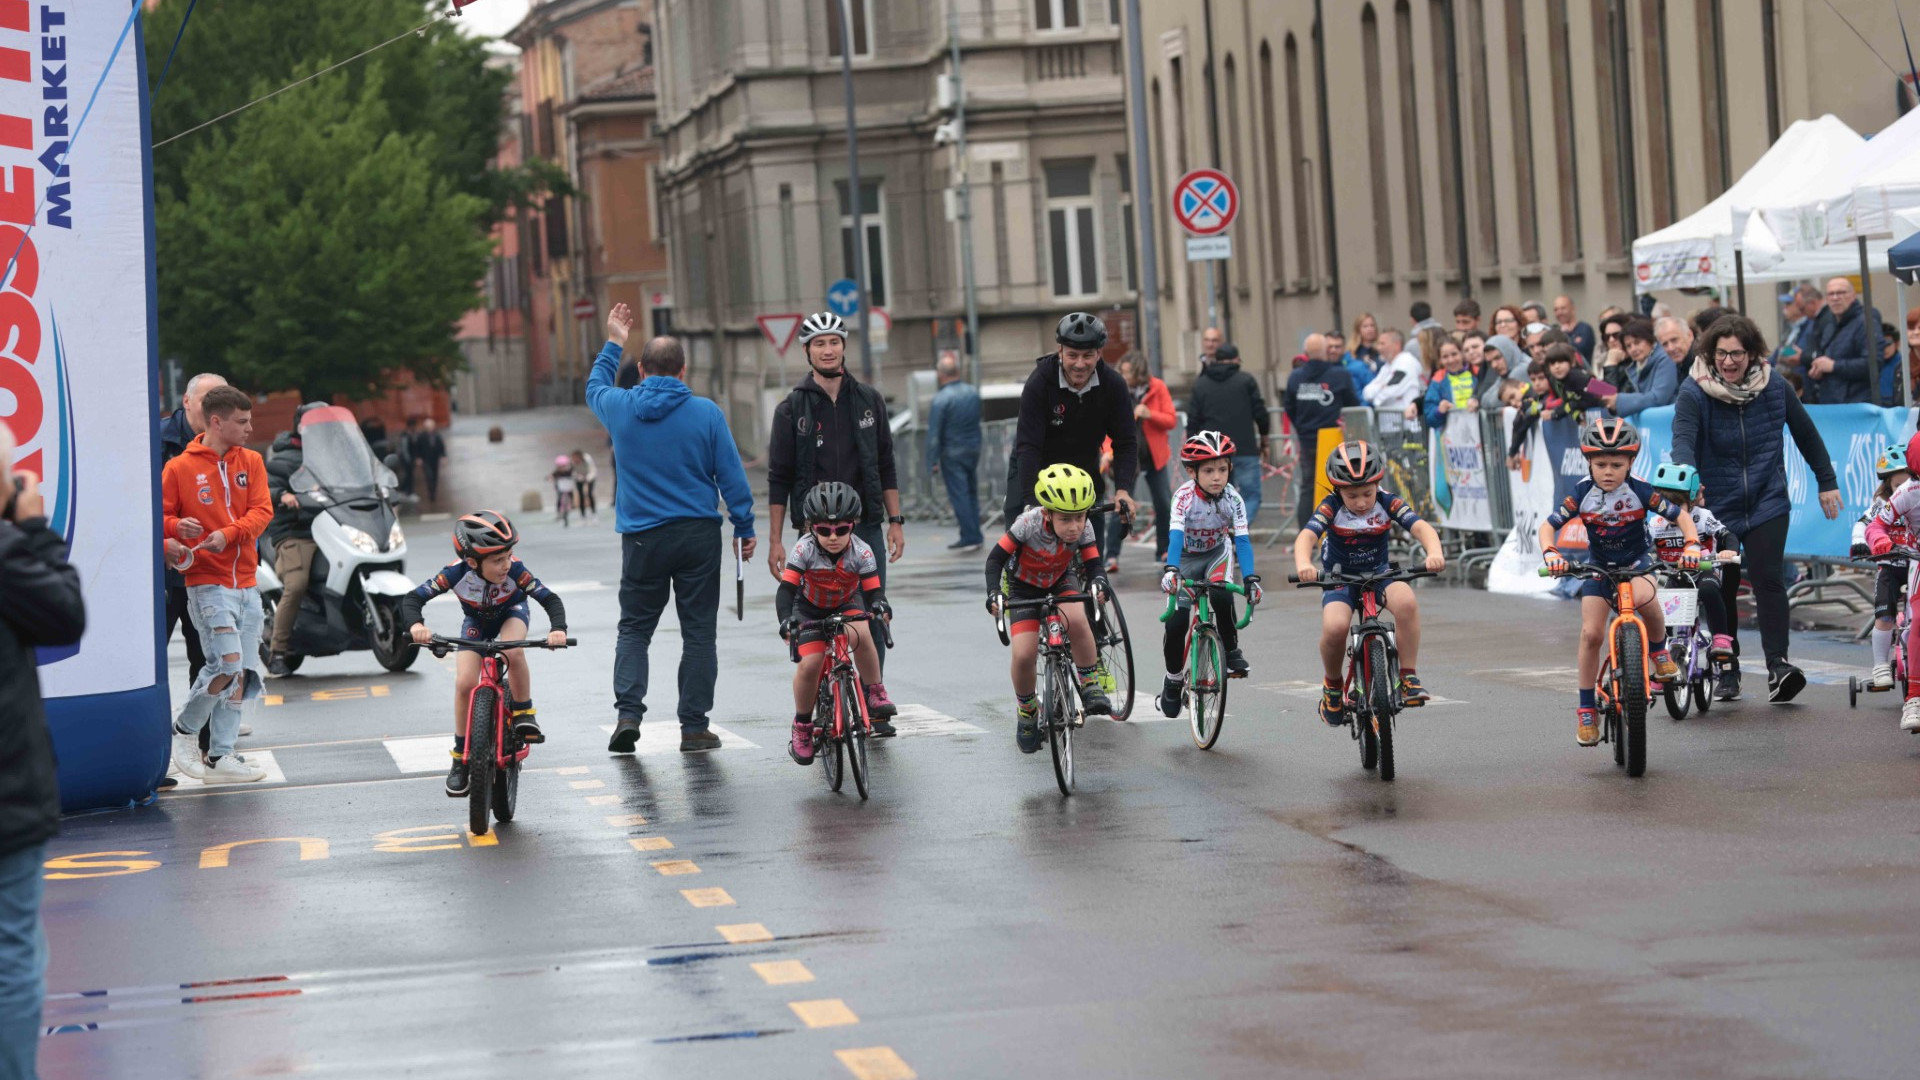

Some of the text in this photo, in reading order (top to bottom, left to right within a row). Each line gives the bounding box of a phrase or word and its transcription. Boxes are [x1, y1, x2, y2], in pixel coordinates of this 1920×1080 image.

[38, 5, 72, 230] MARKET
[1665, 534, 1704, 548] BIEE
[42, 824, 499, 880] BUS
